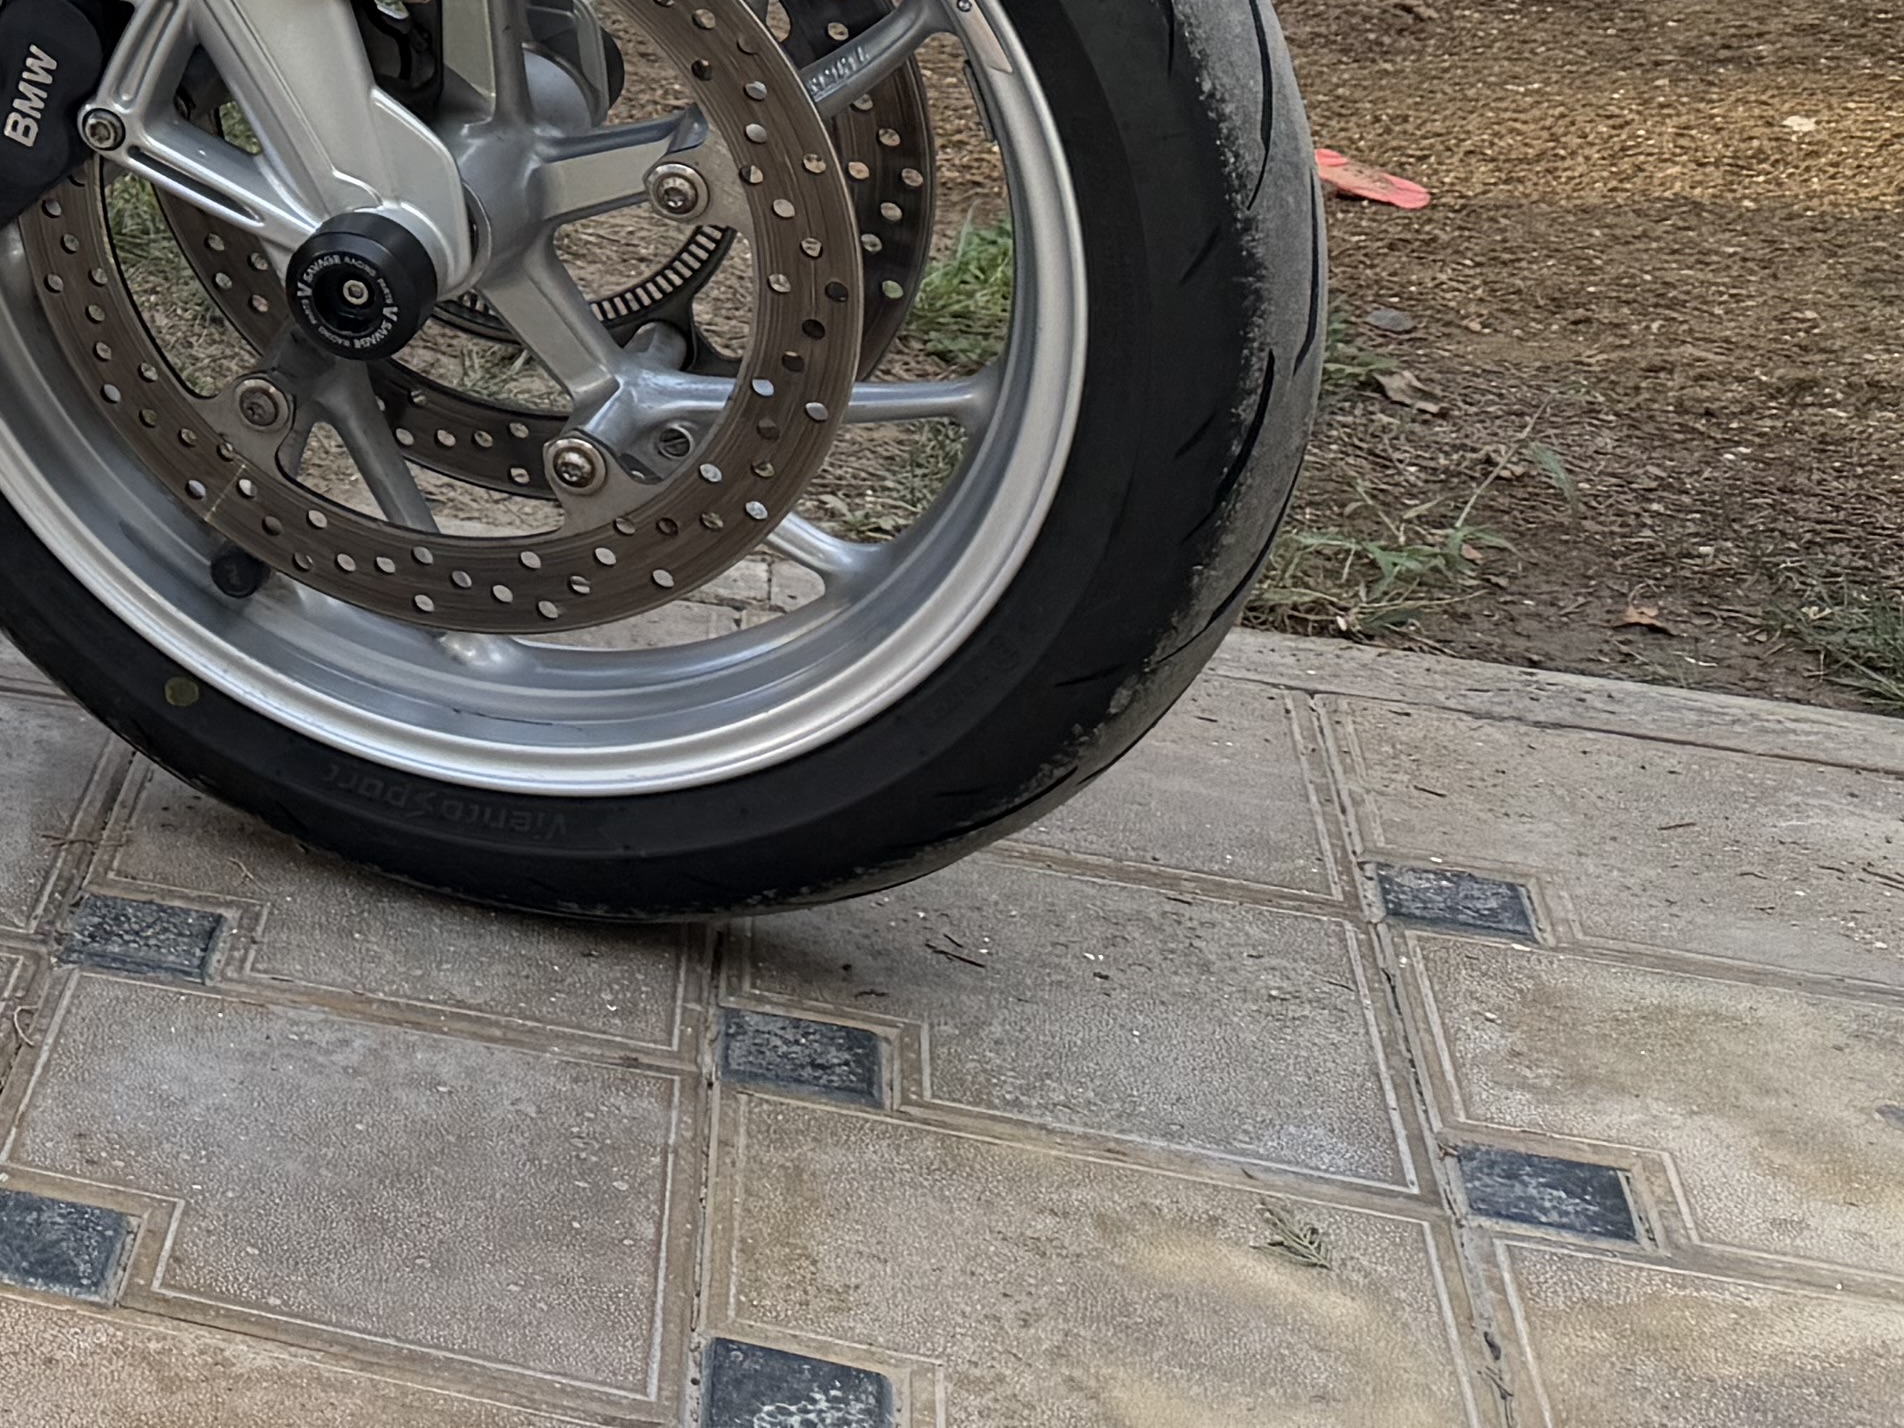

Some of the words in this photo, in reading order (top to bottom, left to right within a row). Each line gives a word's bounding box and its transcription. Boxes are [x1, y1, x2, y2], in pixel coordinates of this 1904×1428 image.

[4, 44, 58, 147] BMW
[303, 254, 341, 283] SAVAGE
[353, 320, 392, 349] SAVAGE
